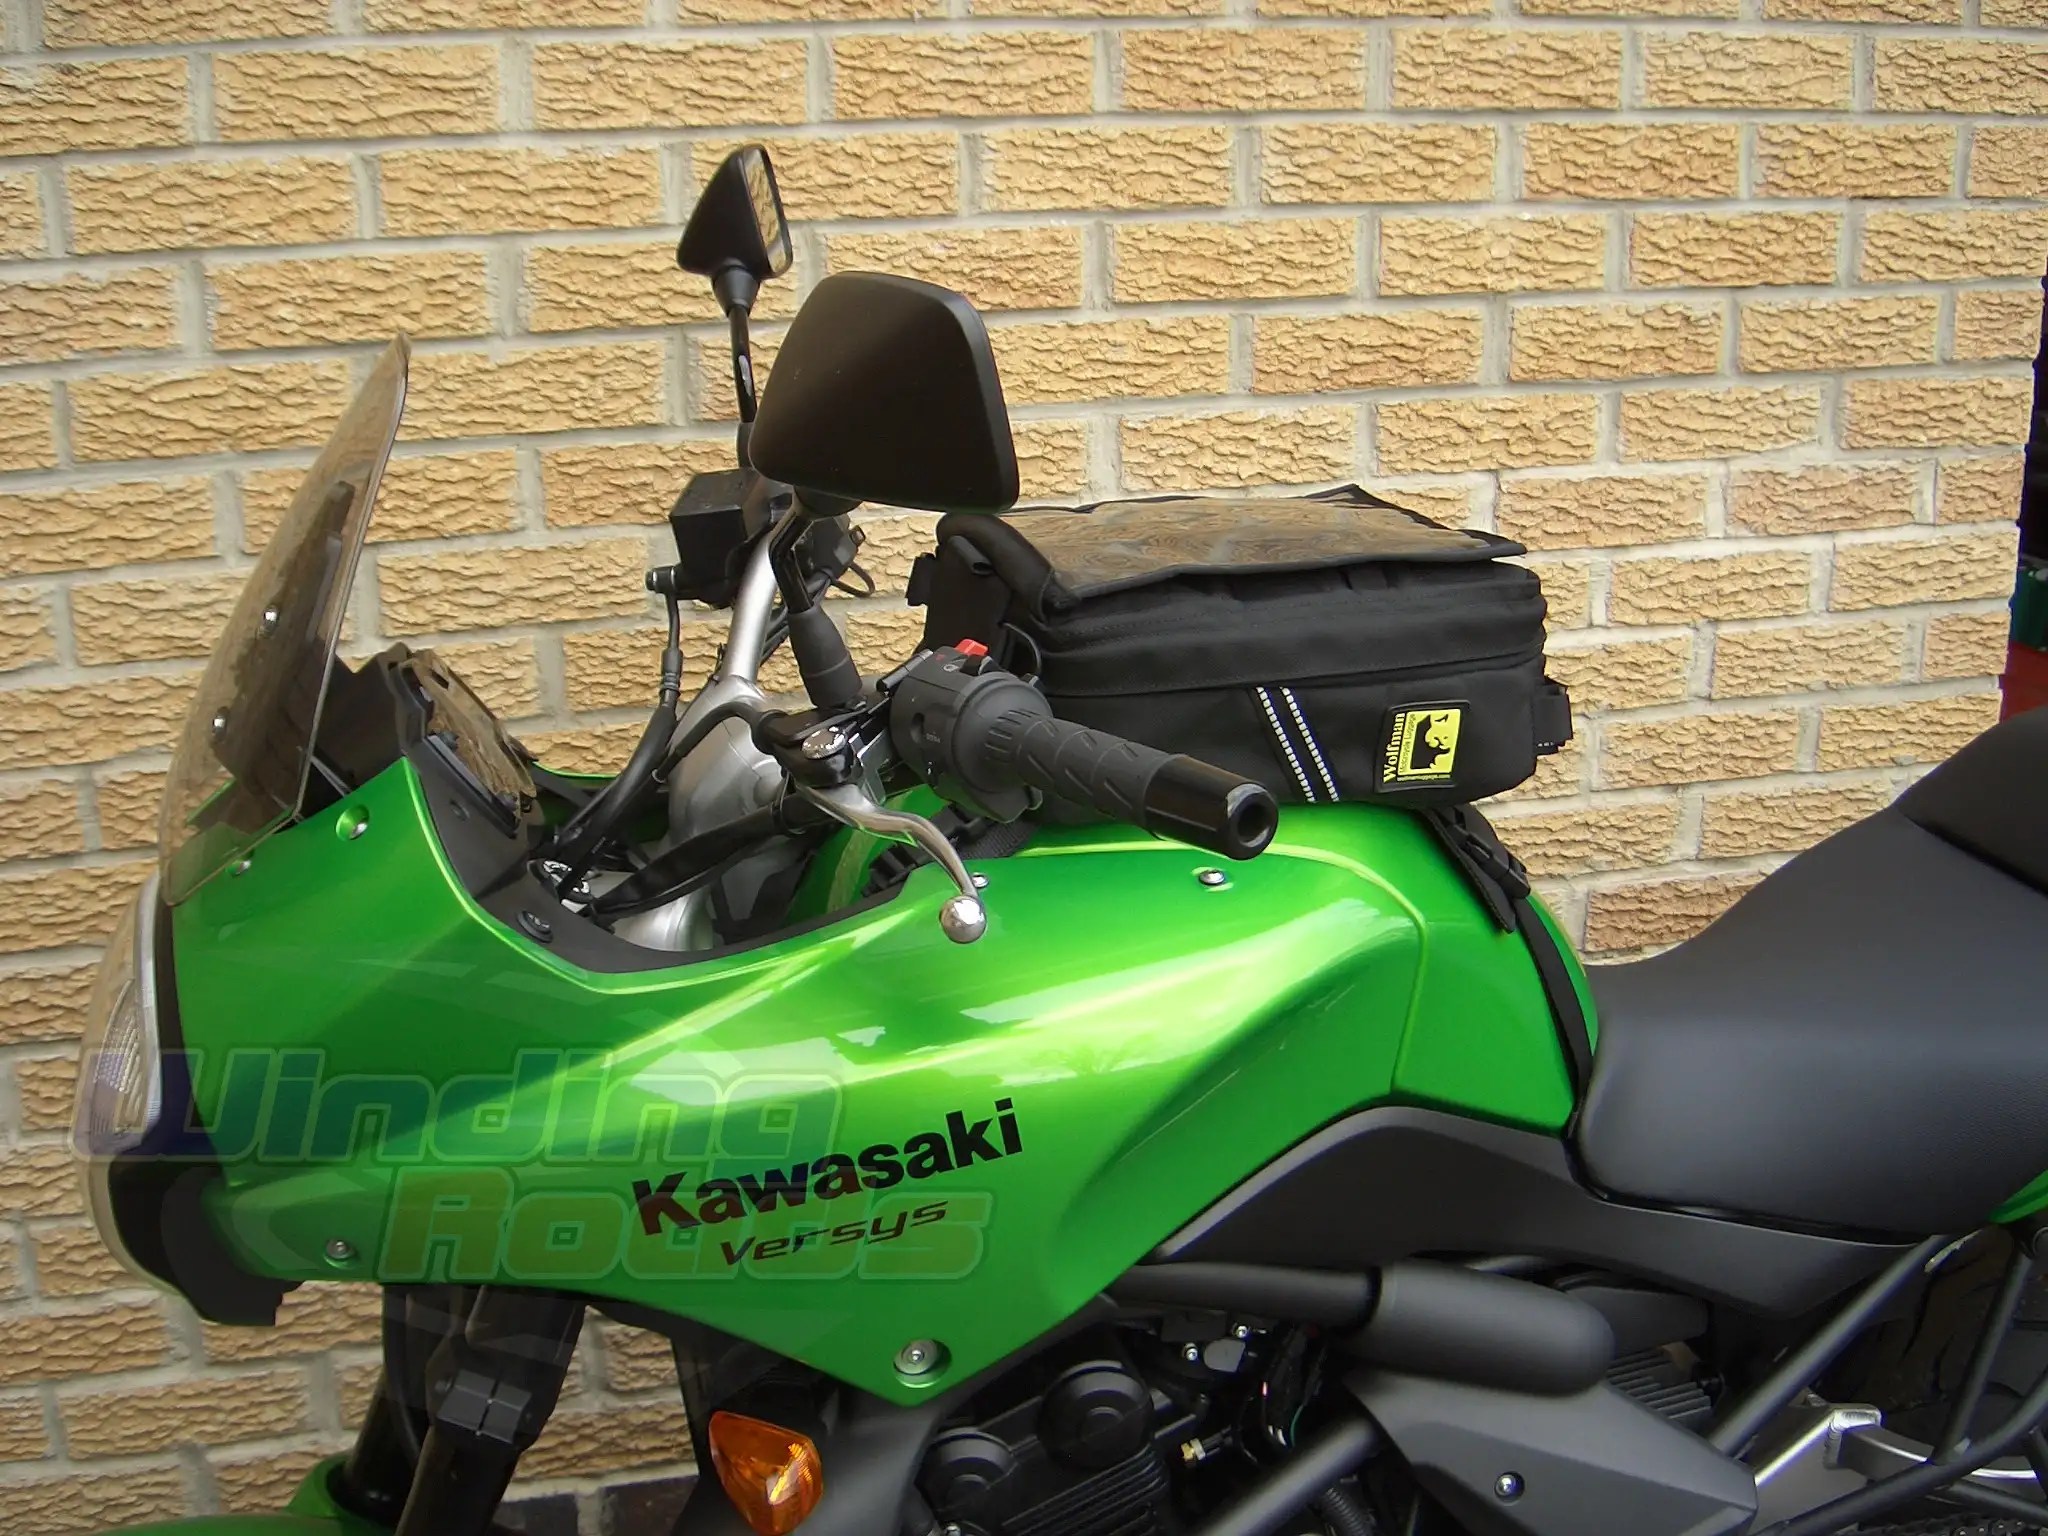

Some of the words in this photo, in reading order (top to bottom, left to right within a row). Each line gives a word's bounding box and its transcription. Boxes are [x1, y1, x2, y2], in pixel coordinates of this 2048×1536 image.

[1383, 712, 1405, 783] Wolfman
[632, 1097, 1023, 1235] Kawasaki
[720, 1201, 948, 1266] Versys
